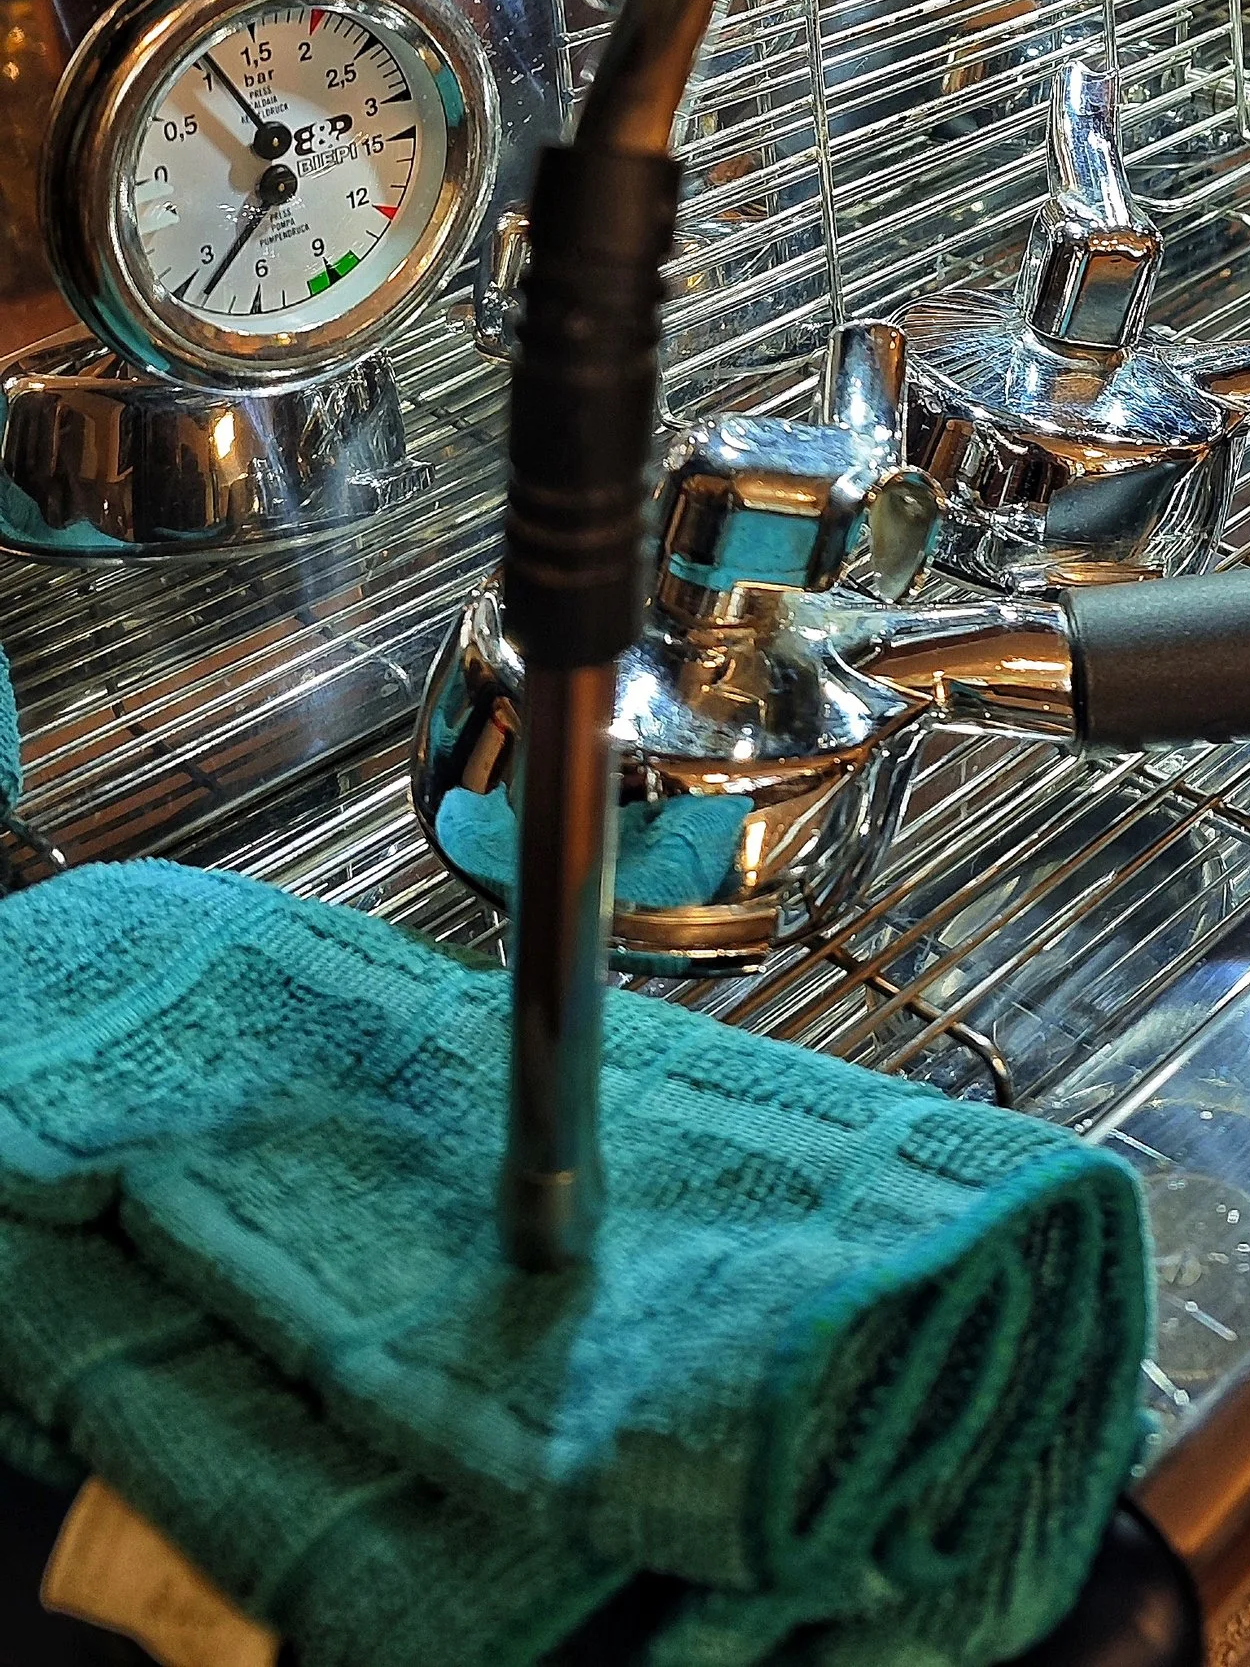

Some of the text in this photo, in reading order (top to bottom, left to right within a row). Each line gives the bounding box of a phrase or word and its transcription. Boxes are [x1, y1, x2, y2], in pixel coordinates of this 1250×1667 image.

[240, 41, 272, 68] 1,5
[298, 42, 313, 62] 2
[203, 72, 213, 92] 1
[243, 69, 274, 87] bar
[325, 62, 357, 89] 2,5
[251, 95, 278, 109] ALDAIA
[364, 97, 378, 117] 3
[164, 114, 198, 142] 0,5
[362, 135, 384, 156] 15
[297, 141, 358, 177] BIEPI
[346, 187, 370, 209] 12
[200, 244, 214, 265] 3
[311, 237, 325, 257] 9
[255, 258, 269, 278] 6
